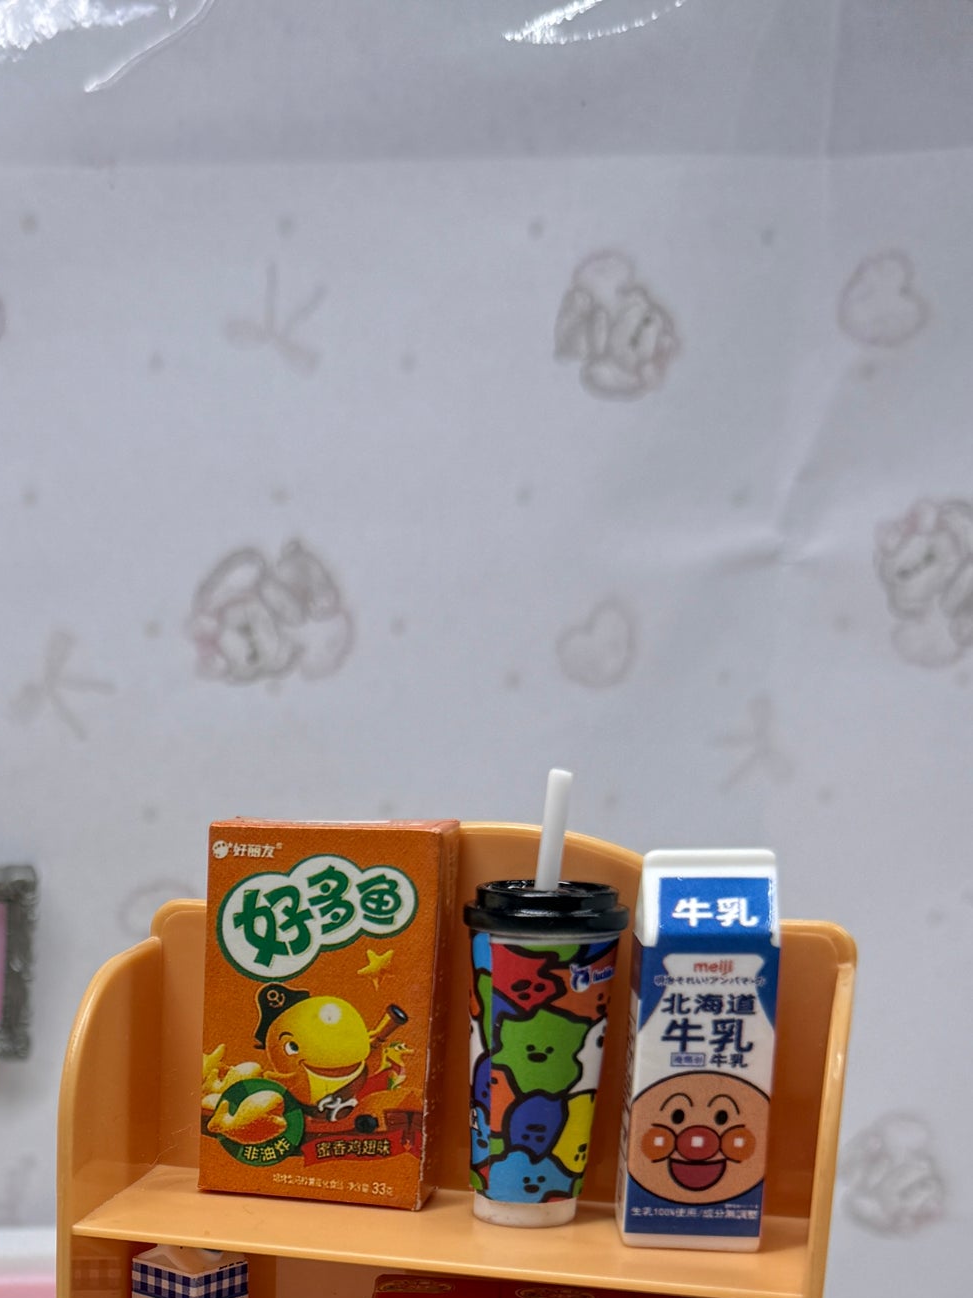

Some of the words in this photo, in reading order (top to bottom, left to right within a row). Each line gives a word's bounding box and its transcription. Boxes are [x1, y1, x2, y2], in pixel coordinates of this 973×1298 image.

[233, 843, 275, 857] 好丽友
[232, 865, 403, 967] 好多鱼
[671, 897, 759, 927] 牛乳
[693, 960, 735, 975] meiji
[661, 993, 756, 1015] 北海道
[661, 1018, 754, 1052] 牛乳
[710, 1054, 748, 1067] 牛乳
[243, 1138, 290, 1162] 非油炸
